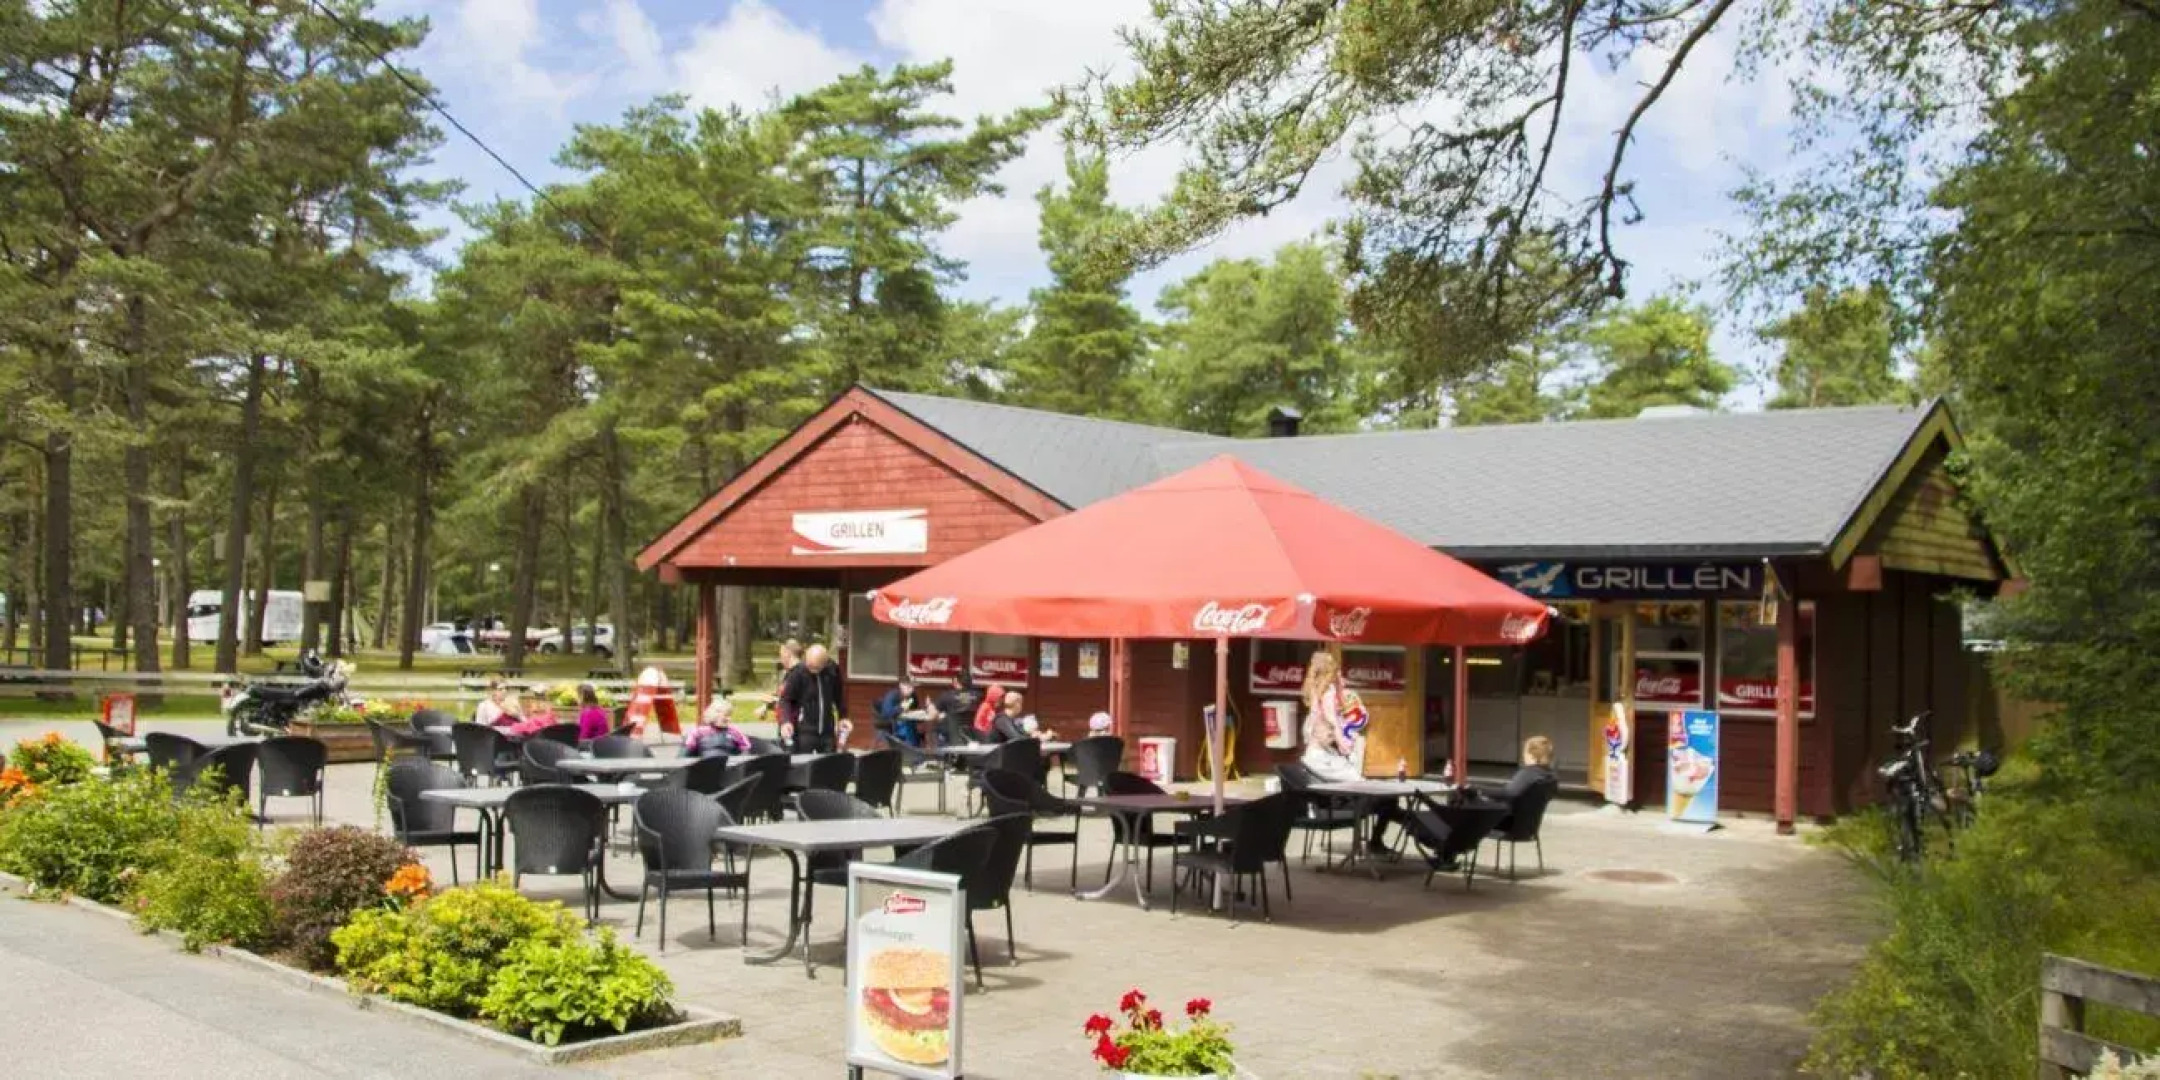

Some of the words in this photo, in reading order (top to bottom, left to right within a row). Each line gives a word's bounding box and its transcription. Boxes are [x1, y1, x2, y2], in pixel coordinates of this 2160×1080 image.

[830, 522, 885, 539] GRILLEN
[1194, 601, 1272, 632] Coca-Cola
[1347, 666, 1394, 681] GRILLEN
[1735, 683, 1779, 700] GRILL
